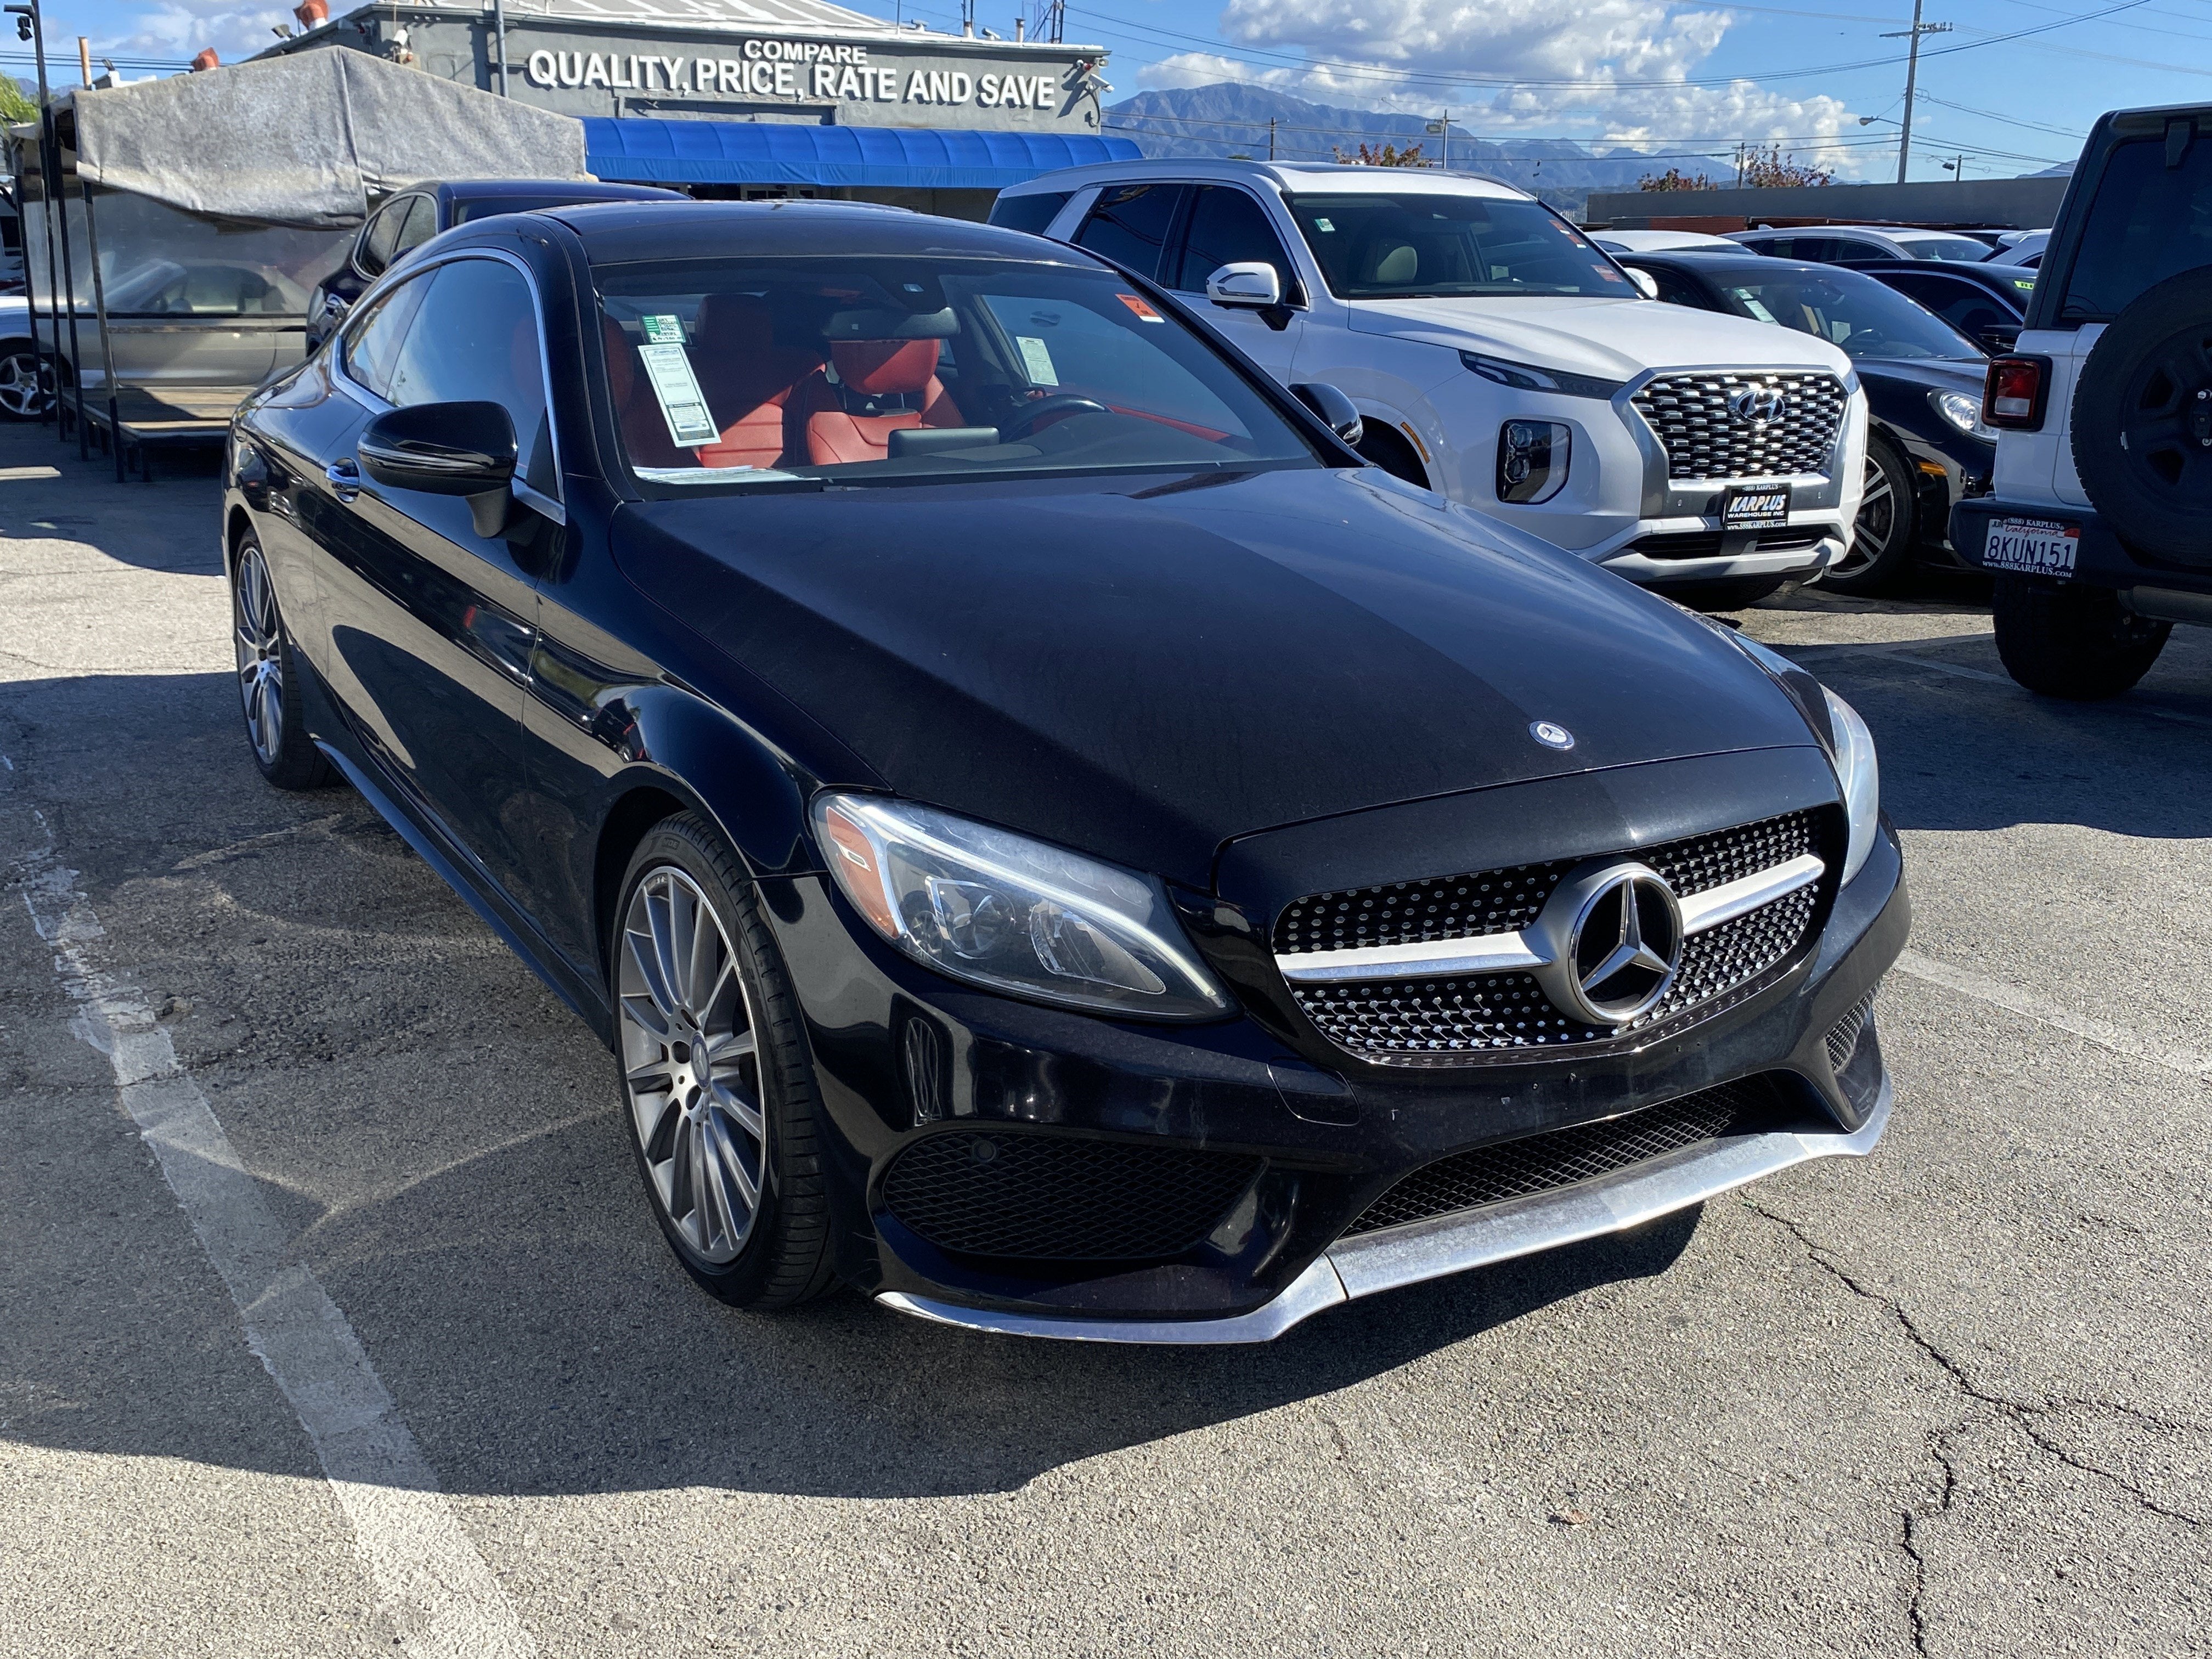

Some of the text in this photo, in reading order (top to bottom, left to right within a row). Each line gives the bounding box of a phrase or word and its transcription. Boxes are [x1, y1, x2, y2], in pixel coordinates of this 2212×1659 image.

[744, 40, 867, 64] COMPARE
[529, 49, 1056, 106] QUALITY, PRICE, RATE AND SAVE
[1729, 495, 1786, 512] KARPLUS
[2006, 525, 2058, 538] California
[2026, 520, 2061, 529] KARPLUS
[1988, 535, 2071, 569] 8KUN151
[1982, 561, 2072, 578] www.888KARPLUS.COM
